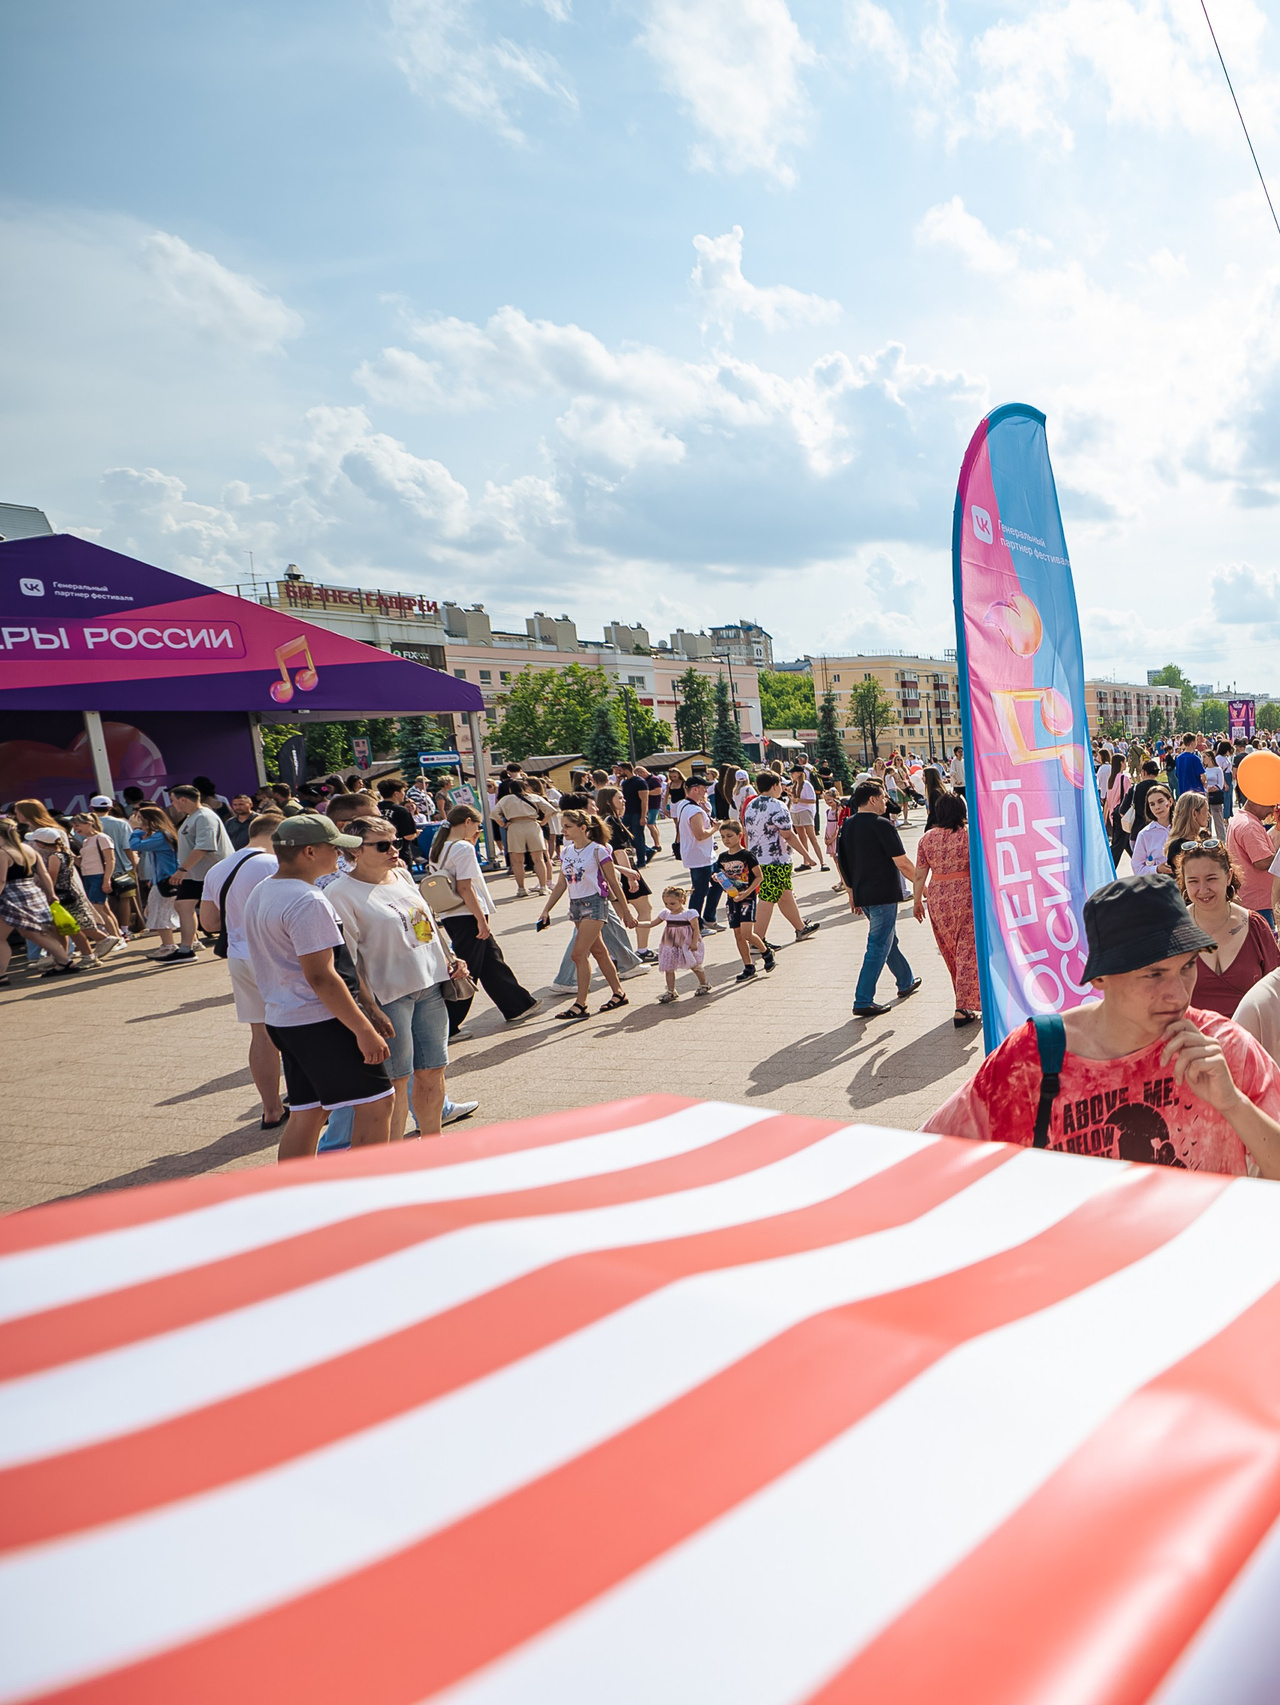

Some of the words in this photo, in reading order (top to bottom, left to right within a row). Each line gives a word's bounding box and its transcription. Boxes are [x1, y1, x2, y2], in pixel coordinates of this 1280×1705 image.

[998, 519, 1046, 547] Генеральный
[1000, 537, 1033, 557] партнер
[53, 581, 108, 592] Генеральный
[54, 590, 90, 600] партнер
[91, 592, 134, 602] фестиваля
[284, 583, 360, 605] БИЗНЕС
[0, 627, 70, 650] РЫ
[83, 627, 234, 650] РОССИИ
[991, 779, 1065, 1013] ОГЕРЫ
[1063, 1087, 1130, 1136] ABOVE
